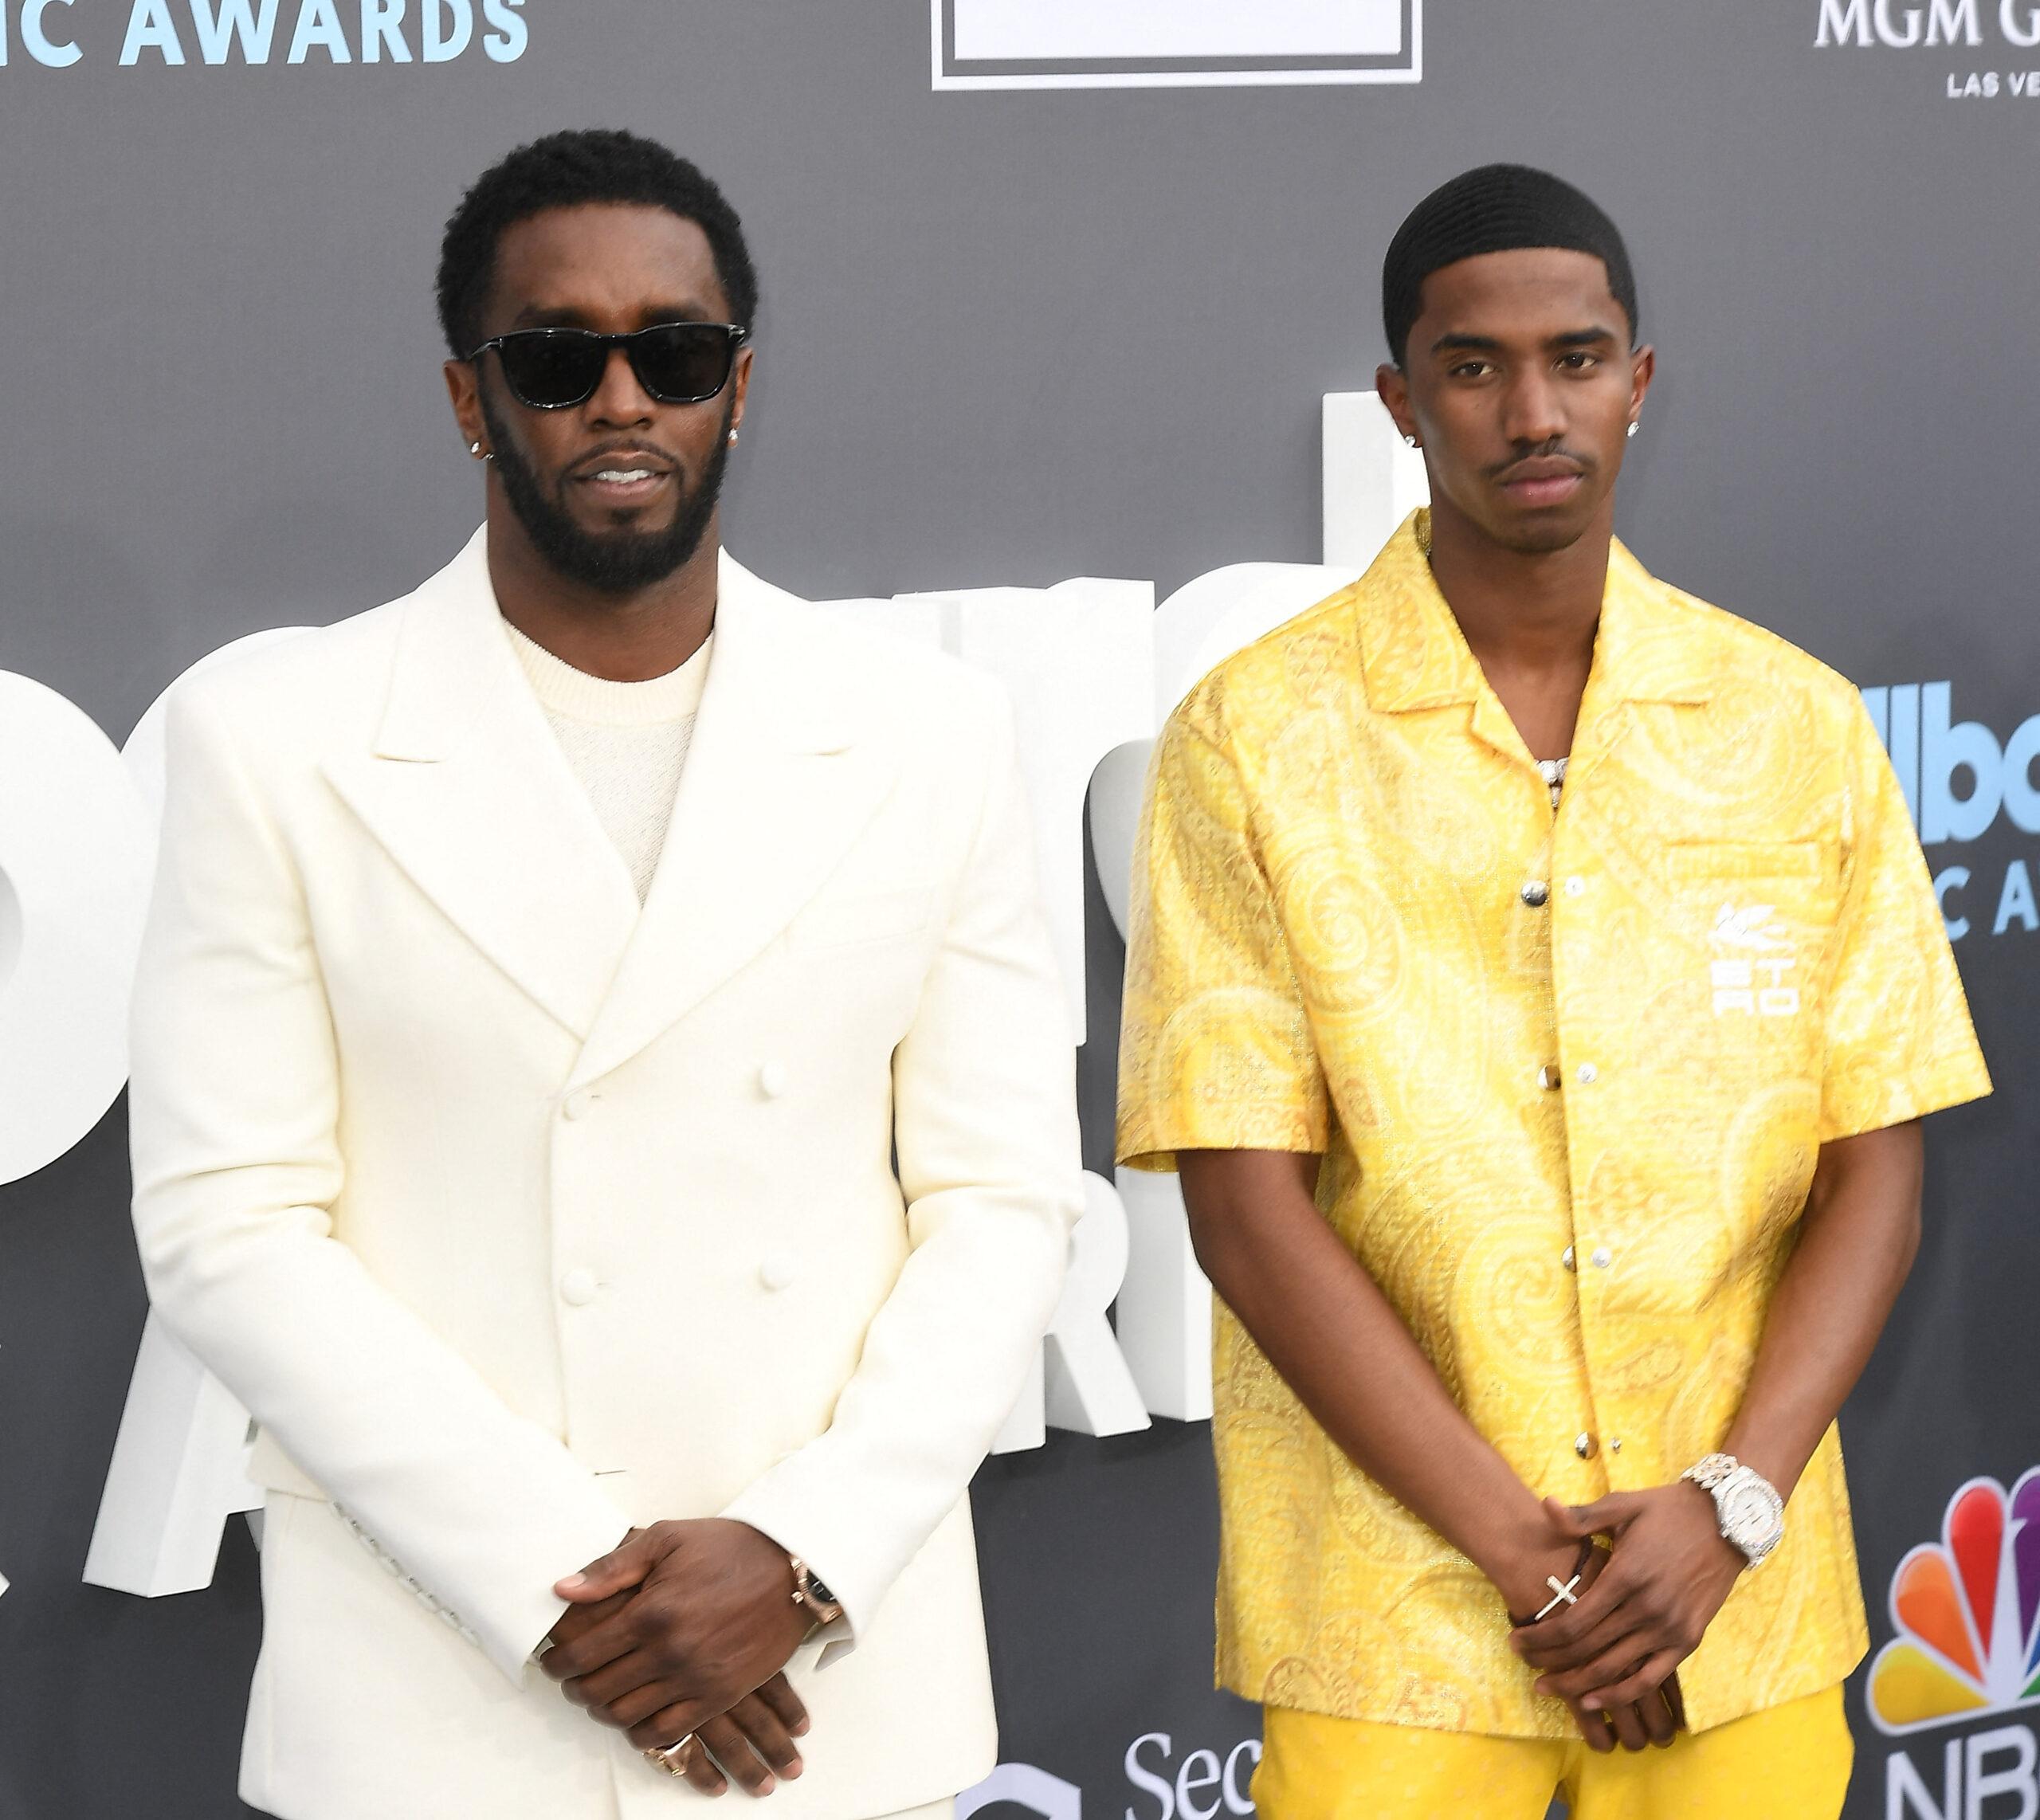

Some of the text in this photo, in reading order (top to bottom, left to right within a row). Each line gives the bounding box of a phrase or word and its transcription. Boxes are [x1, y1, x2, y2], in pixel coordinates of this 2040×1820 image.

[118, 0, 529, 65] AWARDS
[1813, 0, 1983, 48] MGM
[1947, 72, 1999, 98] LAS
